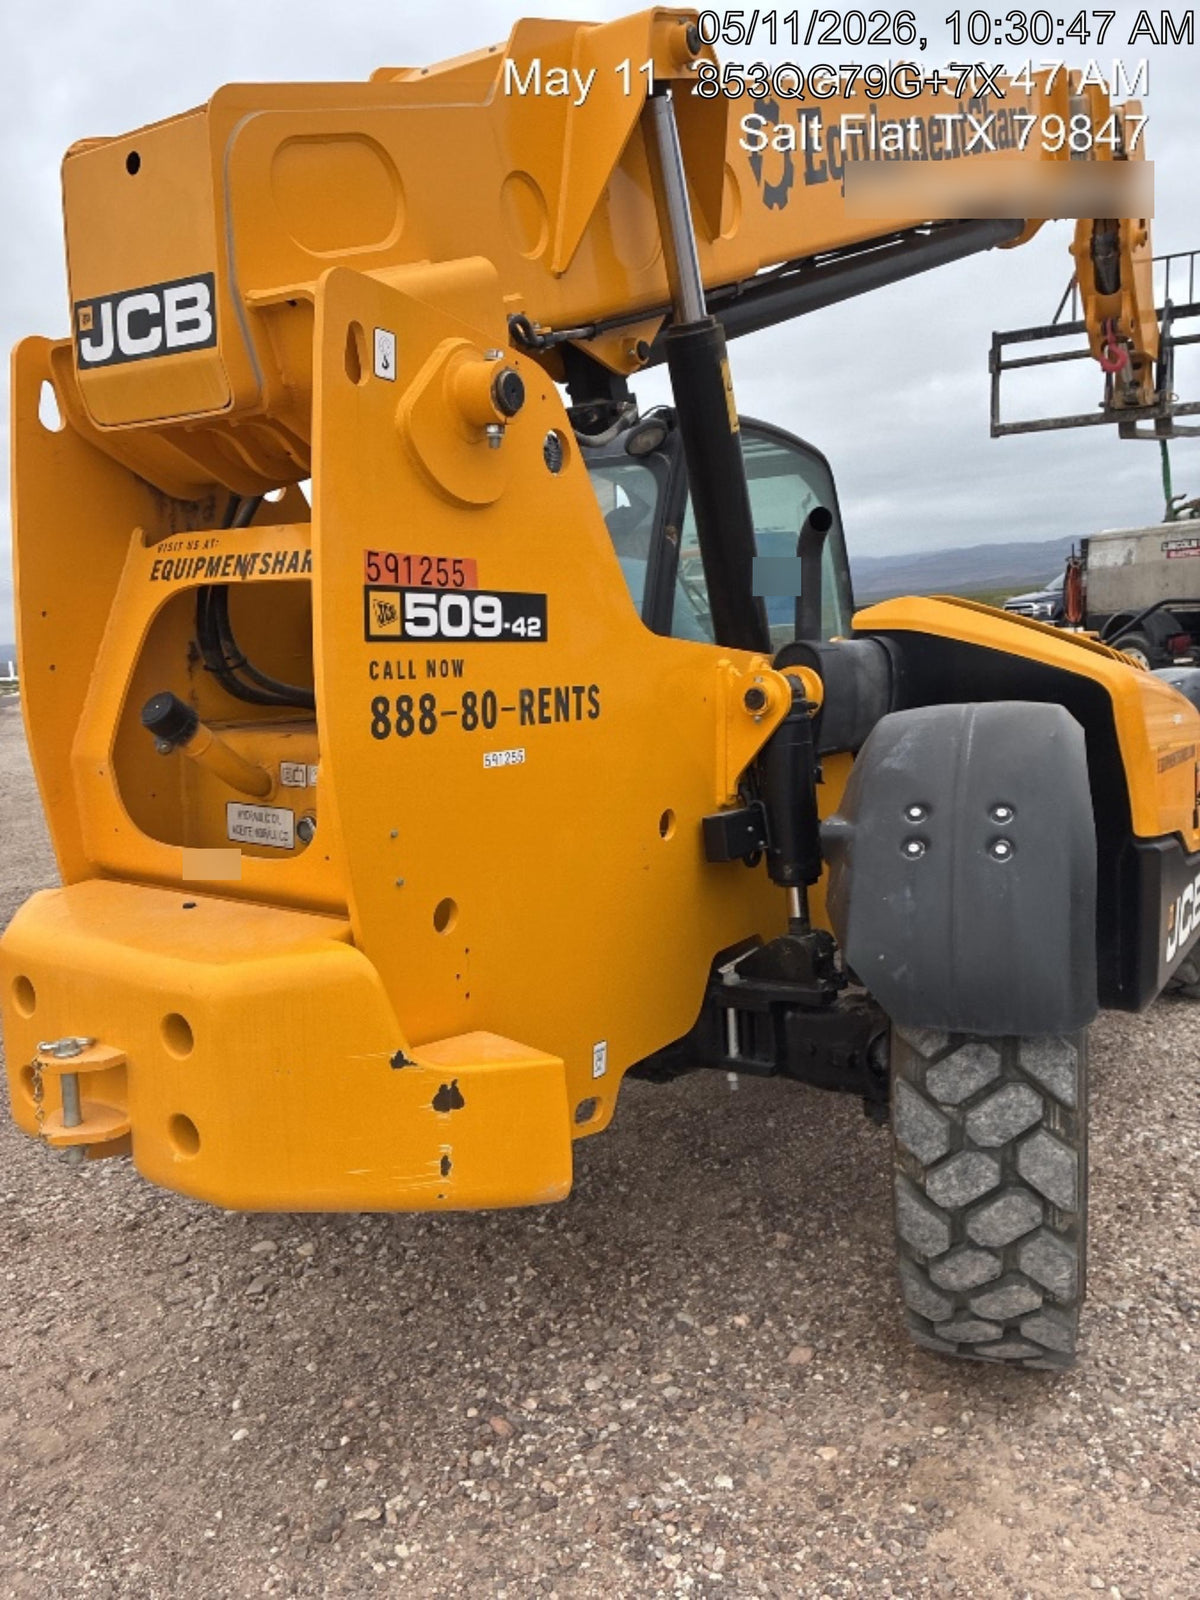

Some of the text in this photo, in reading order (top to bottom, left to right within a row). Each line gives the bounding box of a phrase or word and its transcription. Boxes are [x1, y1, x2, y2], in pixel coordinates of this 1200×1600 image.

[80, 282, 213, 362] JCB
[367, 551, 465, 587] 591255
[369, 659, 465, 680] CALL NOW
[371, 684, 601, 740] 888-80-RENTS
